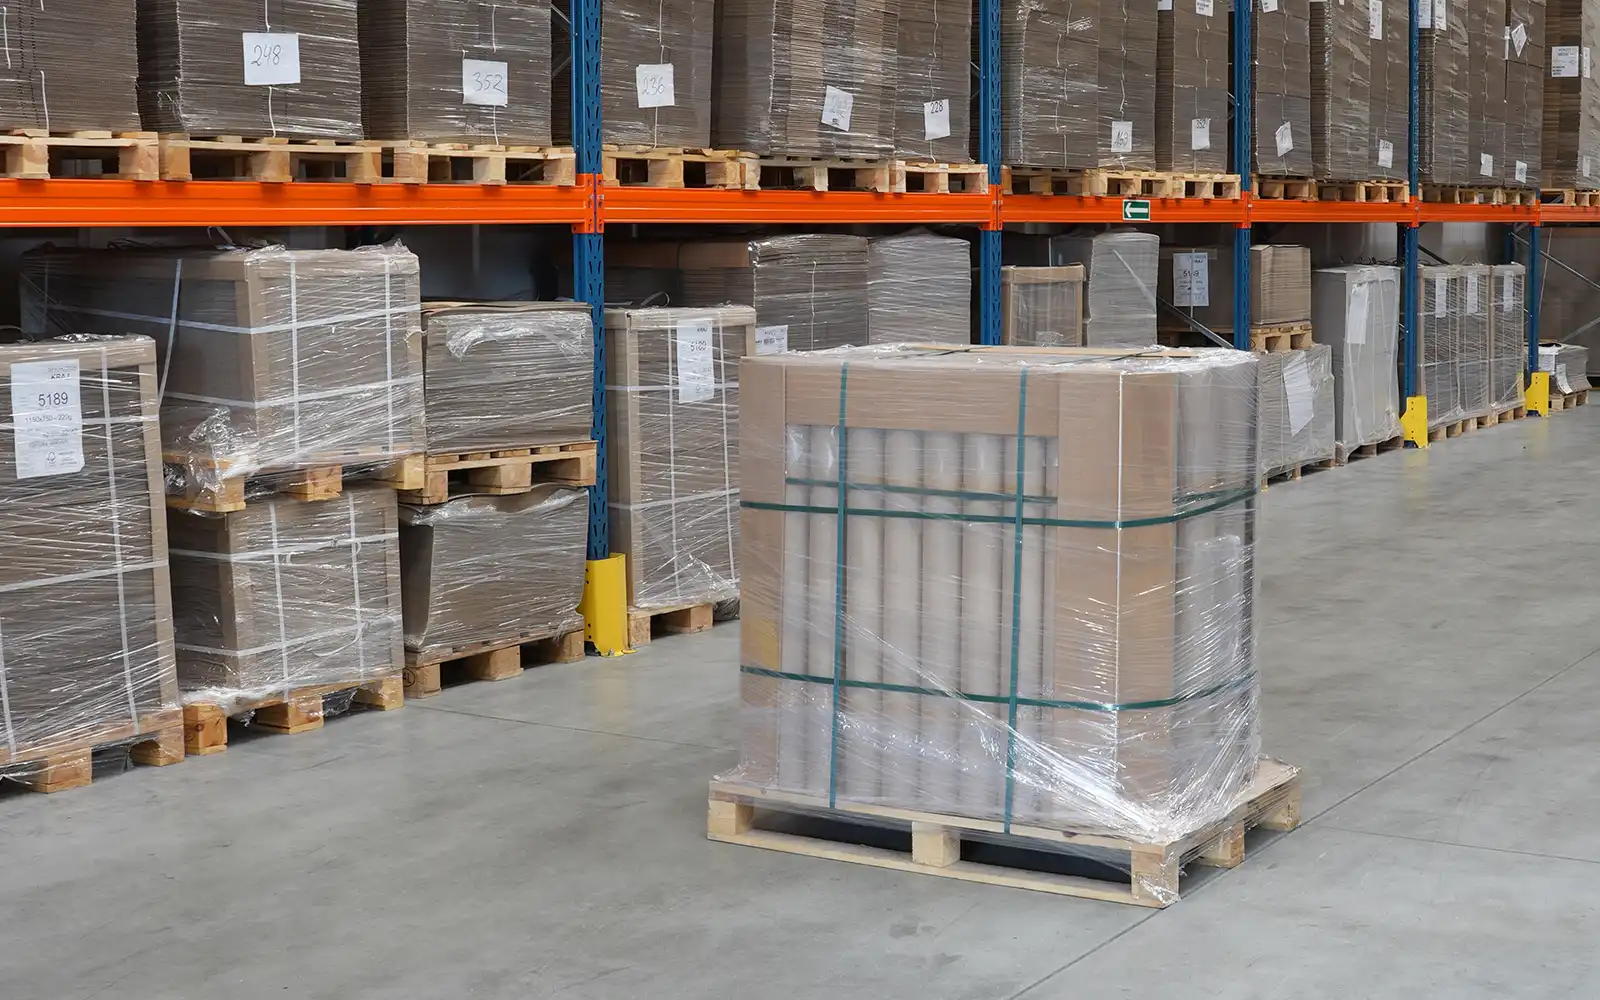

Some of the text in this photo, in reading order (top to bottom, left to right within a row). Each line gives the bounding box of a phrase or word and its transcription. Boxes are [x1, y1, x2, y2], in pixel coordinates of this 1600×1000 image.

[251, 44, 281, 67] 248
[473, 72, 505, 93] 352
[642, 76, 665, 96] 236
[931, 101, 944, 114] 228
[38, 392, 68, 407] 5189
